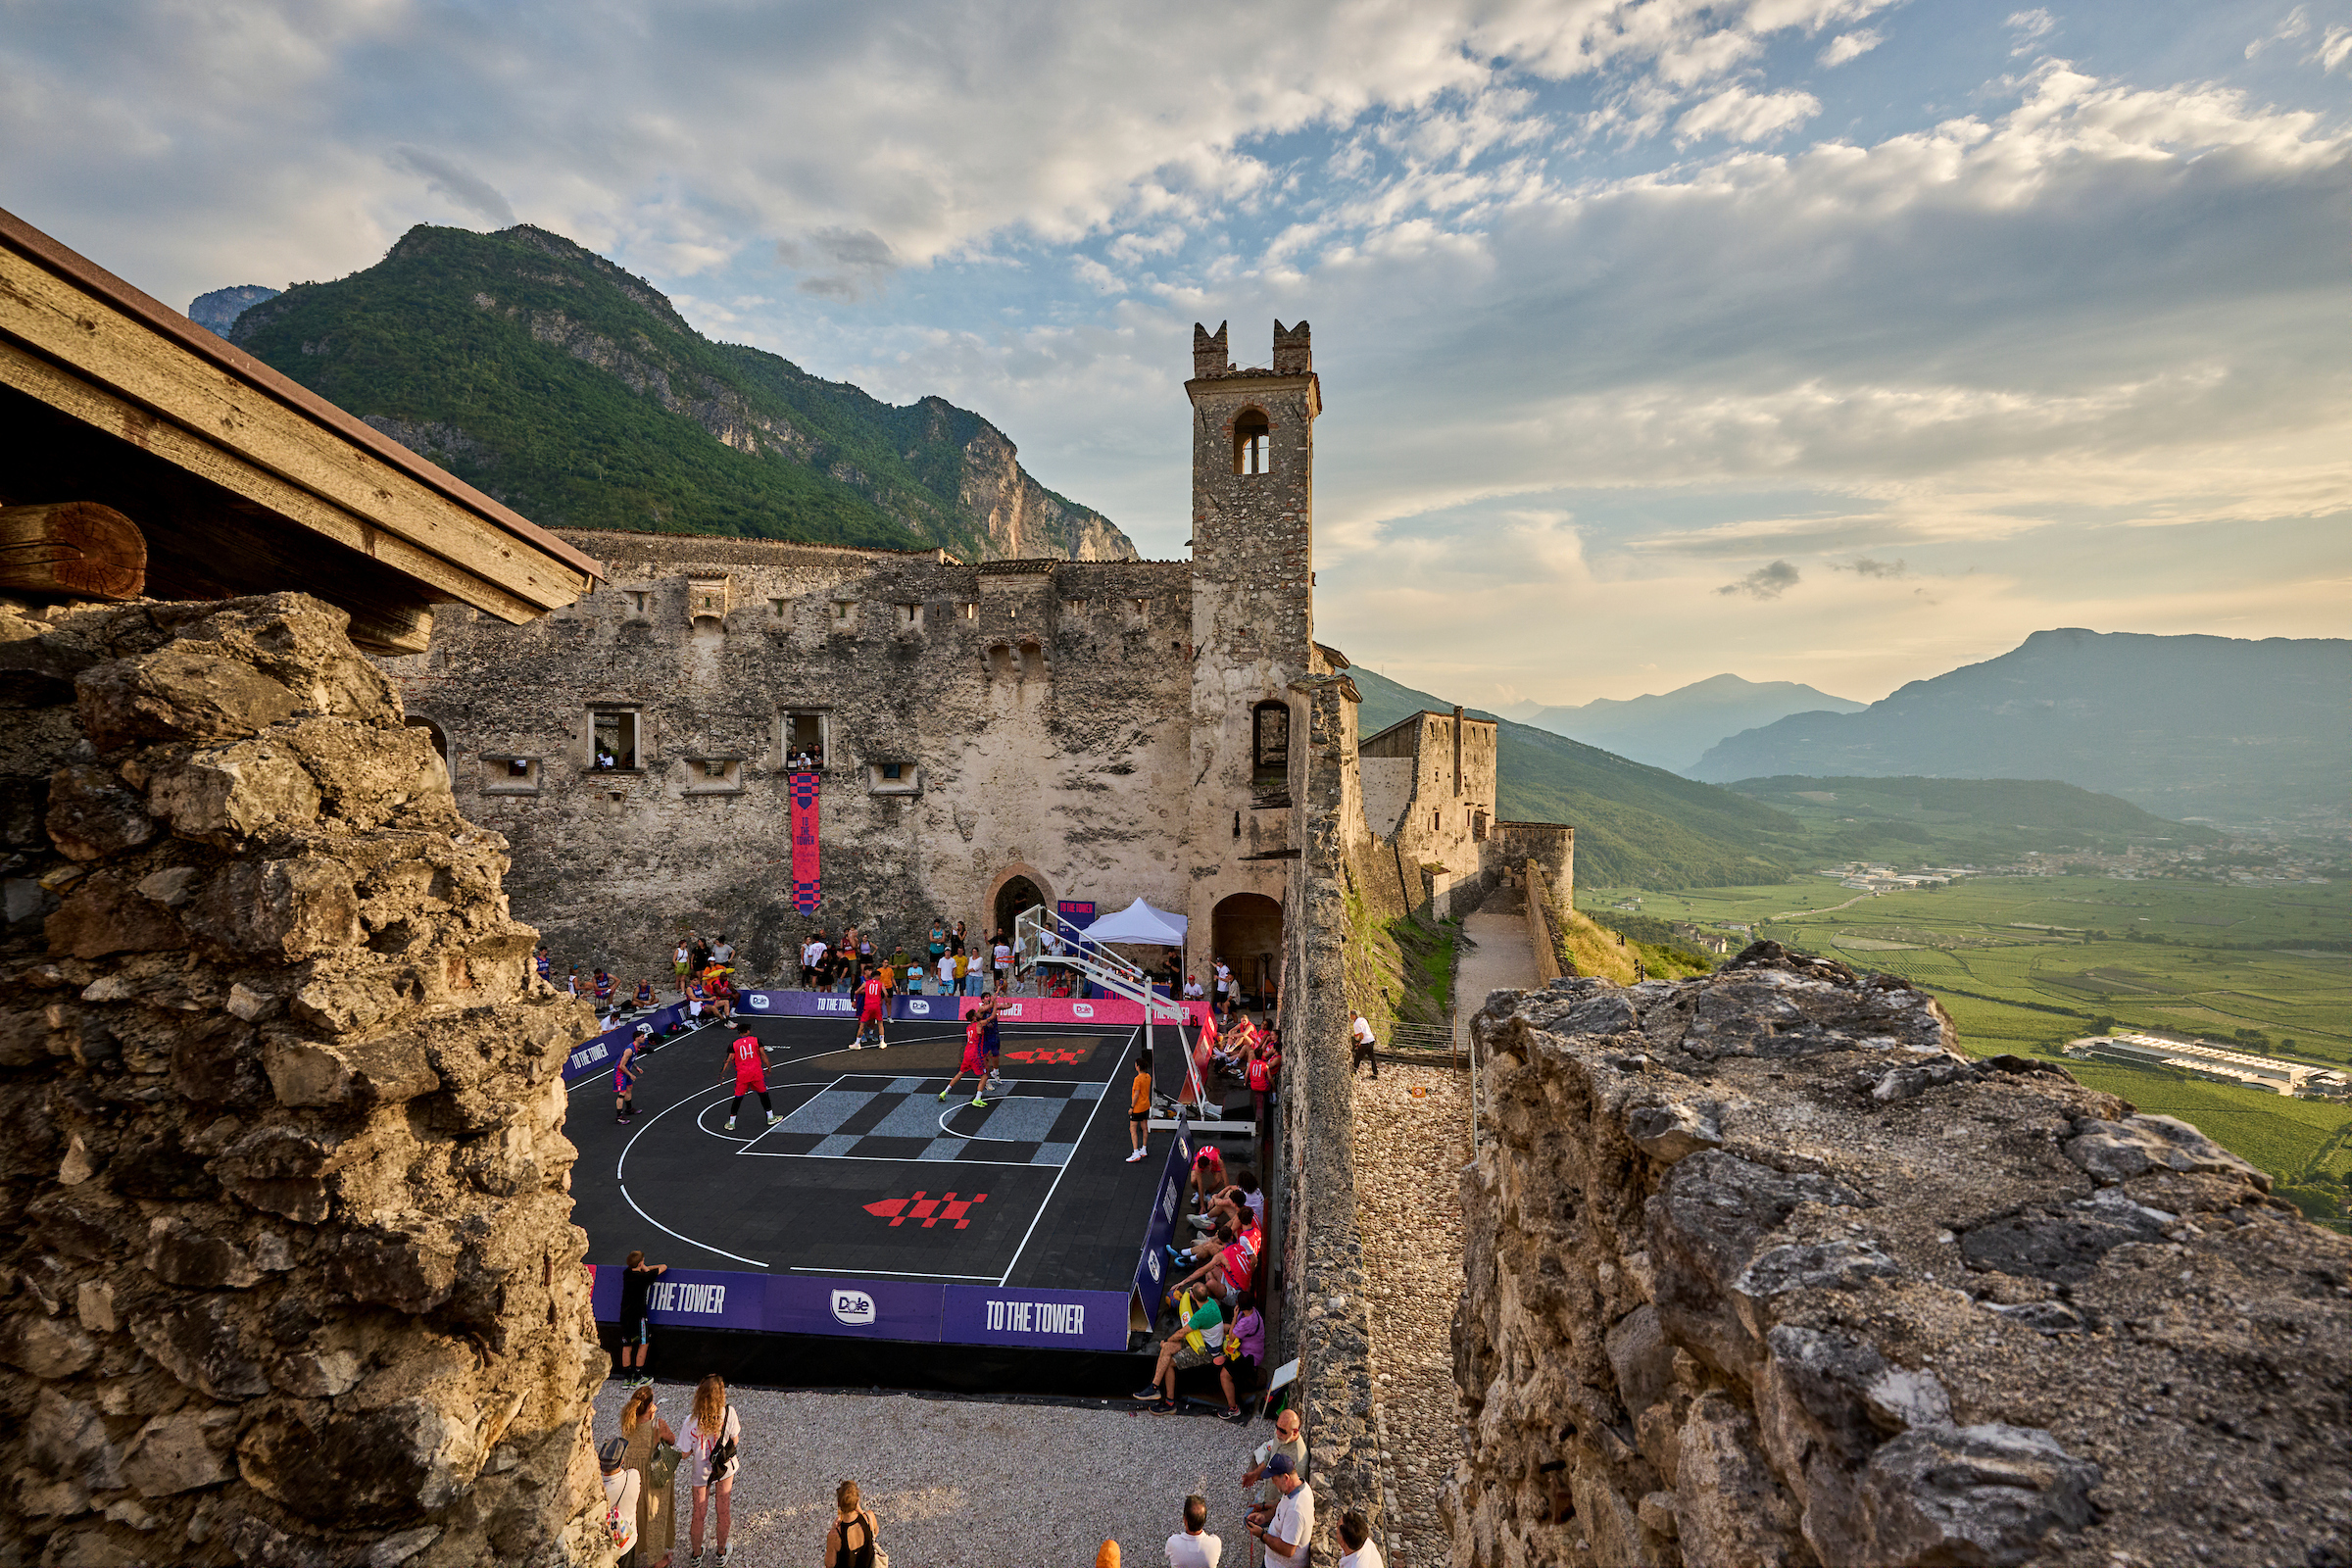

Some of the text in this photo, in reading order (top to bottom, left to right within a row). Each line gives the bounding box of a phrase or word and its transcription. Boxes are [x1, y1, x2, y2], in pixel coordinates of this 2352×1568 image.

[1059, 902, 1093, 913] TO THE TOWER
[868, 983, 879, 996] 01
[817, 998, 827, 1010] TO
[826, 998, 839, 1011] THE
[570, 1042, 609, 1070] TO THE TOWER
[739, 1043, 755, 1060] 04
[1251, 1063, 1262, 1077] 01
[651, 1282, 677, 1311] THE
[677, 1283, 725, 1314] TOWER
[838, 1296, 870, 1311] Dole
[986, 1300, 1085, 1335] TO THE TOWER
